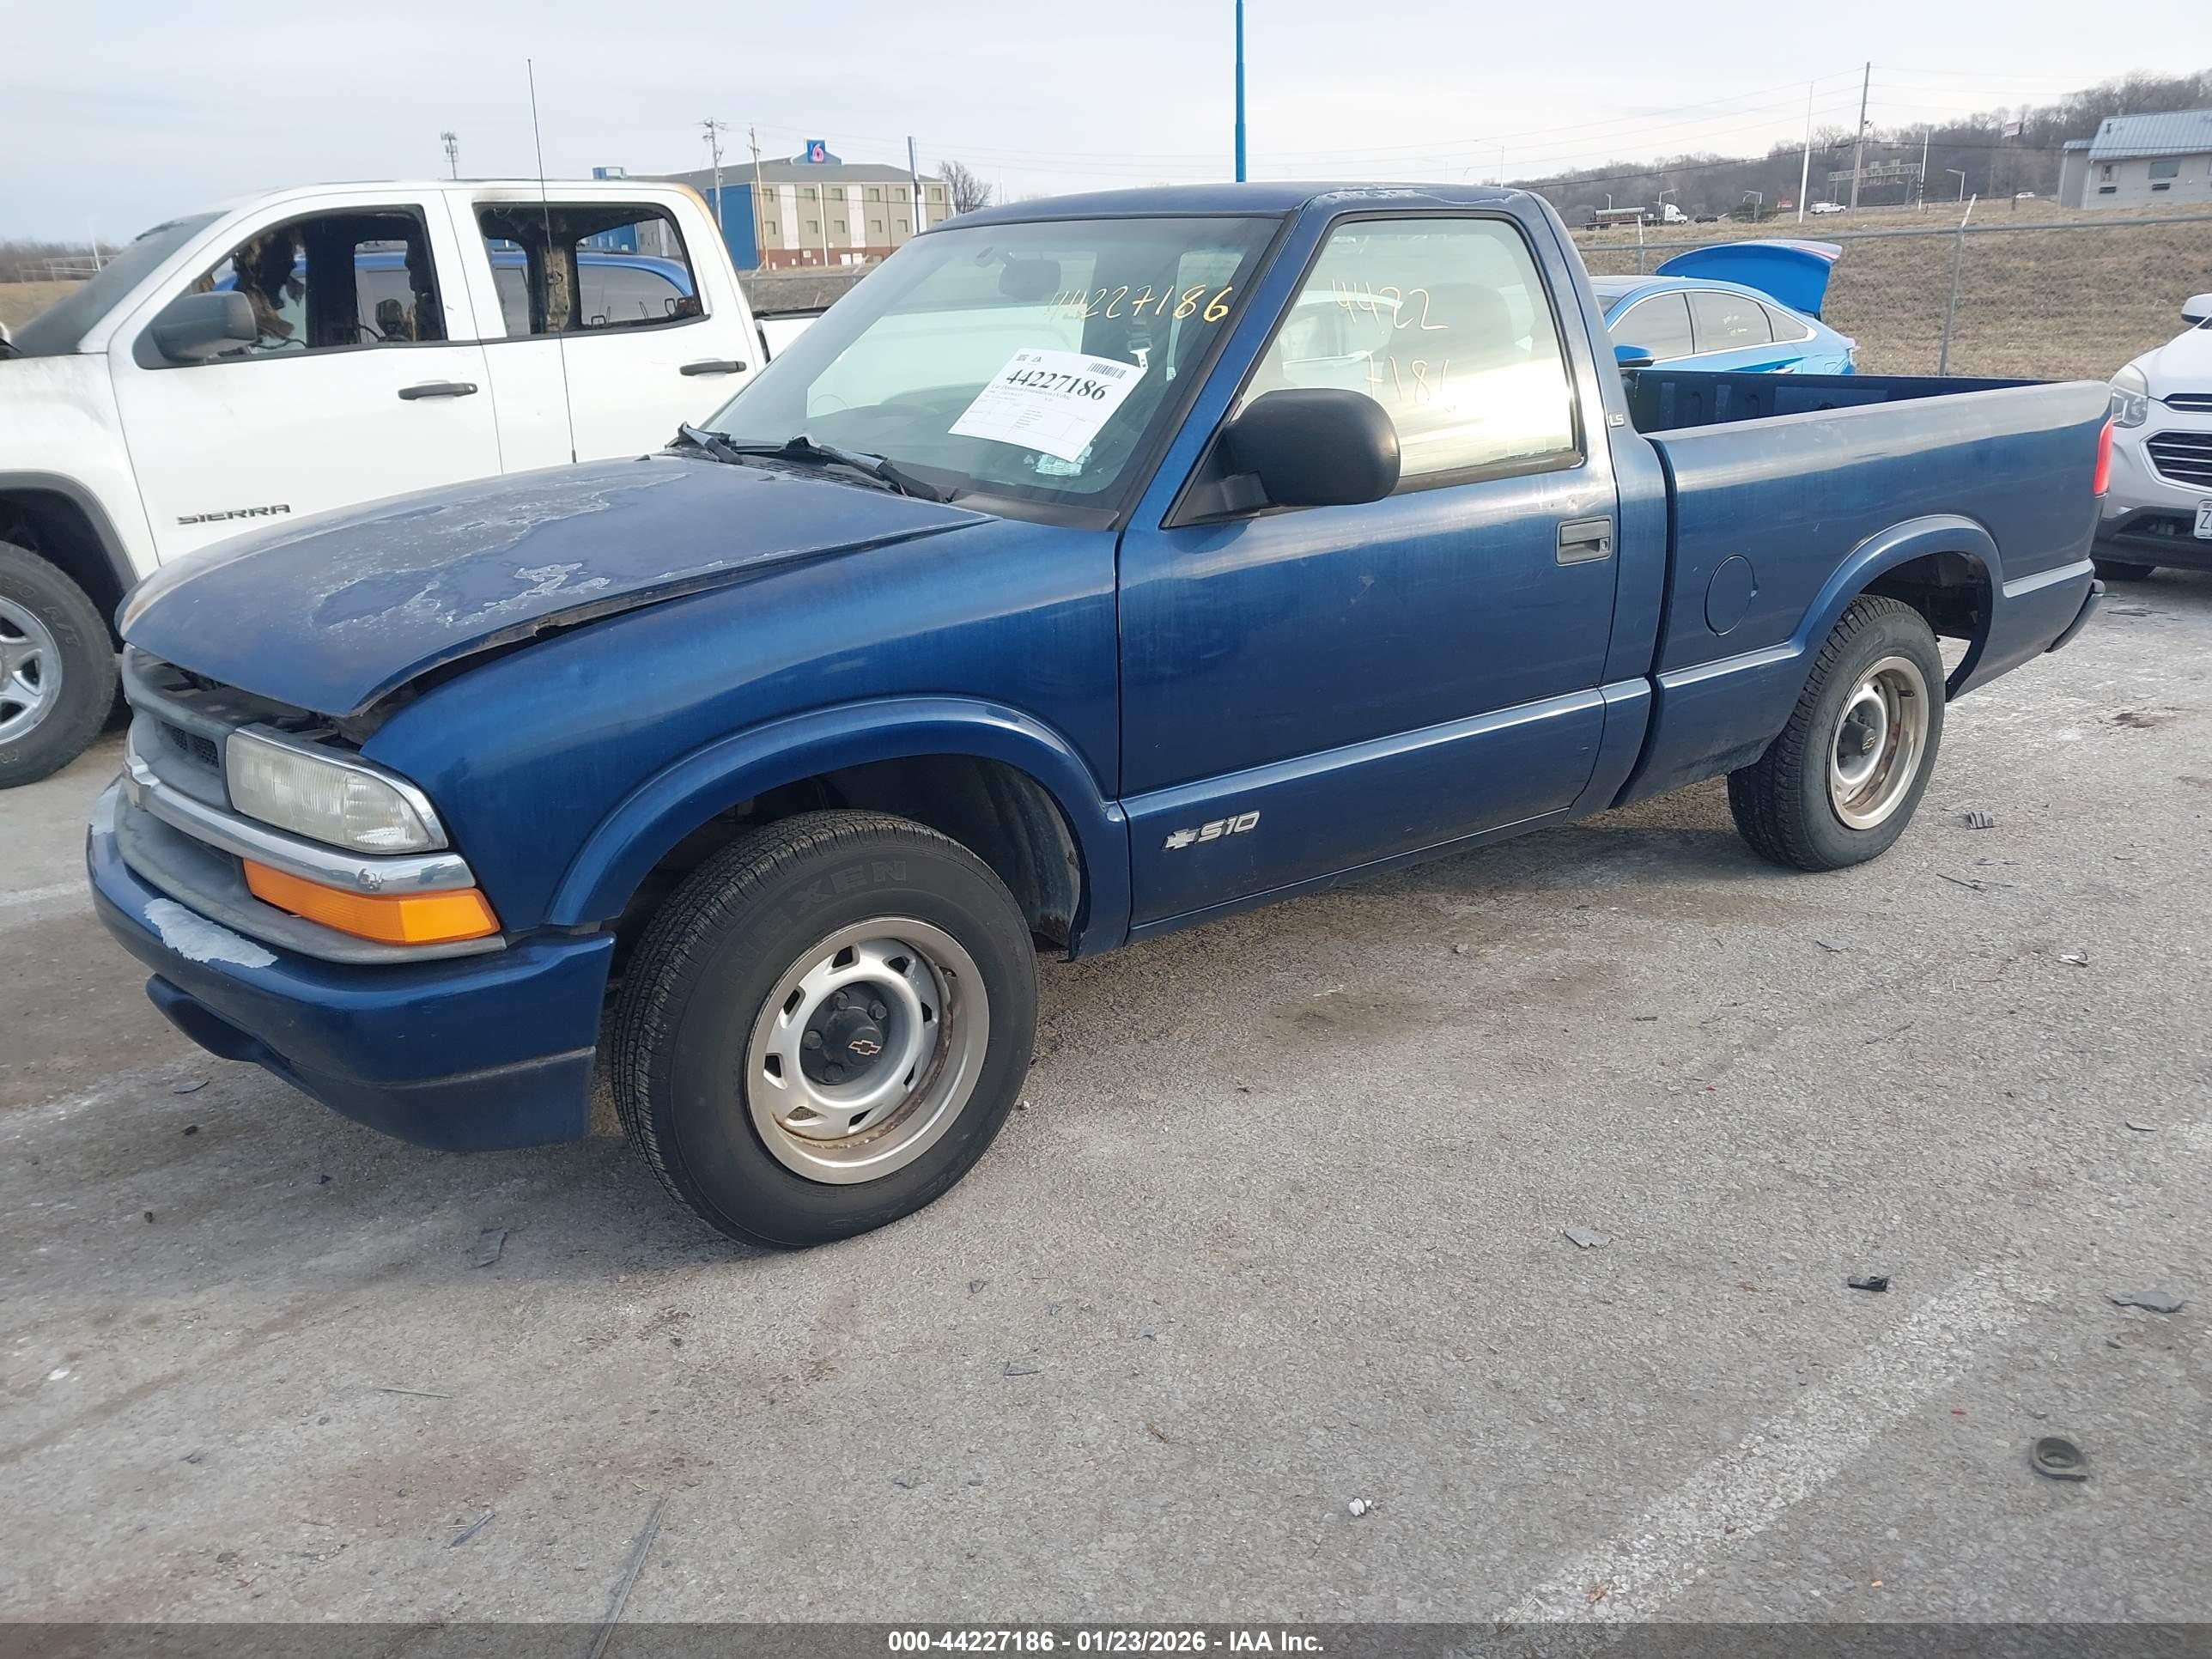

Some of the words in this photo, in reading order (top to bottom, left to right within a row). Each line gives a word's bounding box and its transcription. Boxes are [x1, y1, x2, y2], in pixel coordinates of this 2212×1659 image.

[812, 143, 824, 162] 6
[1045, 284, 1233, 323] 44227186
[1331, 279, 1449, 331] 4422
[1006, 368, 1113, 401] 44227186
[1607, 412, 1625, 428] LS
[177, 503, 291, 525] SIERRA
[1194, 810, 1261, 844] S10
